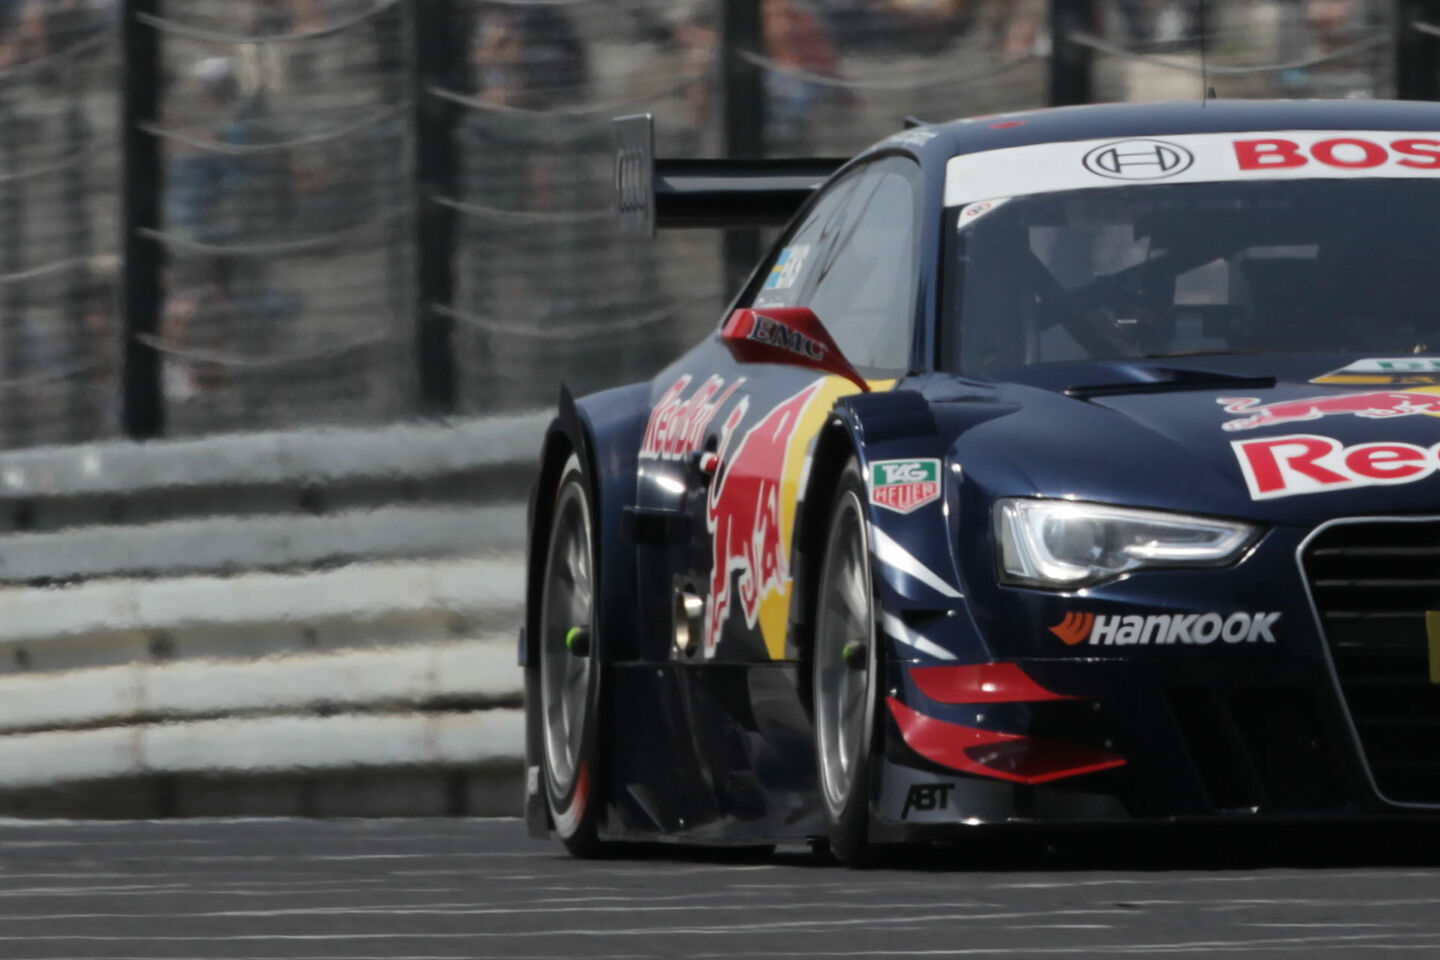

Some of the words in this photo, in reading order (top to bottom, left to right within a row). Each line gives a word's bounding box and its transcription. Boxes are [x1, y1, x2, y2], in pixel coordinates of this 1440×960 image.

[747, 310, 828, 361] EMC
[882, 462, 930, 484] TAG
[874, 483, 936, 509] HEUER
[901, 782, 956, 821] ABT
